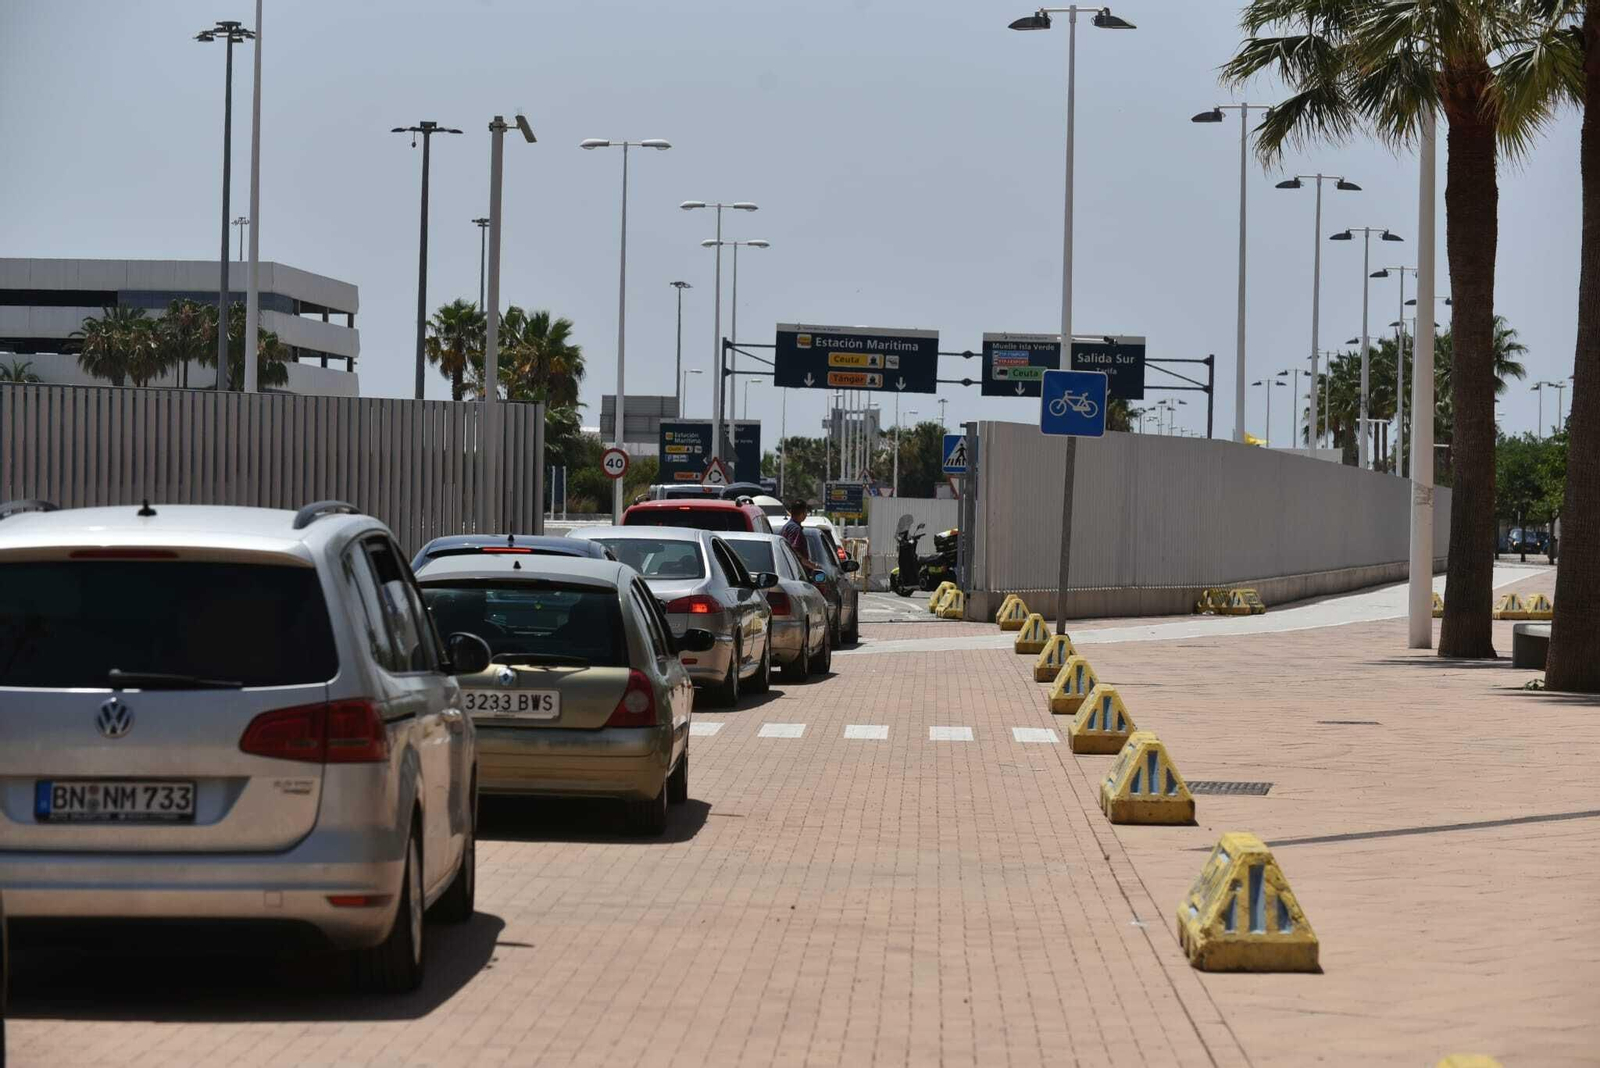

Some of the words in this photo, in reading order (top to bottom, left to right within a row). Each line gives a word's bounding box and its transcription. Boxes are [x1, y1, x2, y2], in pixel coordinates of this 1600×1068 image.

[815, 337, 863, 349] Estación
[866, 339, 919, 351] Marítima
[992, 342, 1017, 350] Muelle
[833, 355, 860, 364] Ceuta
[1077, 353, 1113, 364] Salida
[1116, 354, 1135, 364] Sur
[1012, 369, 1039, 378] Ceuta
[605, 459, 624, 469] 40
[465, 693, 512, 711] 3233
[518, 694, 553, 711] BWS
[52, 785, 86, 810] BN
[102, 785, 137, 810] NM
[142, 785, 191, 810] 733
